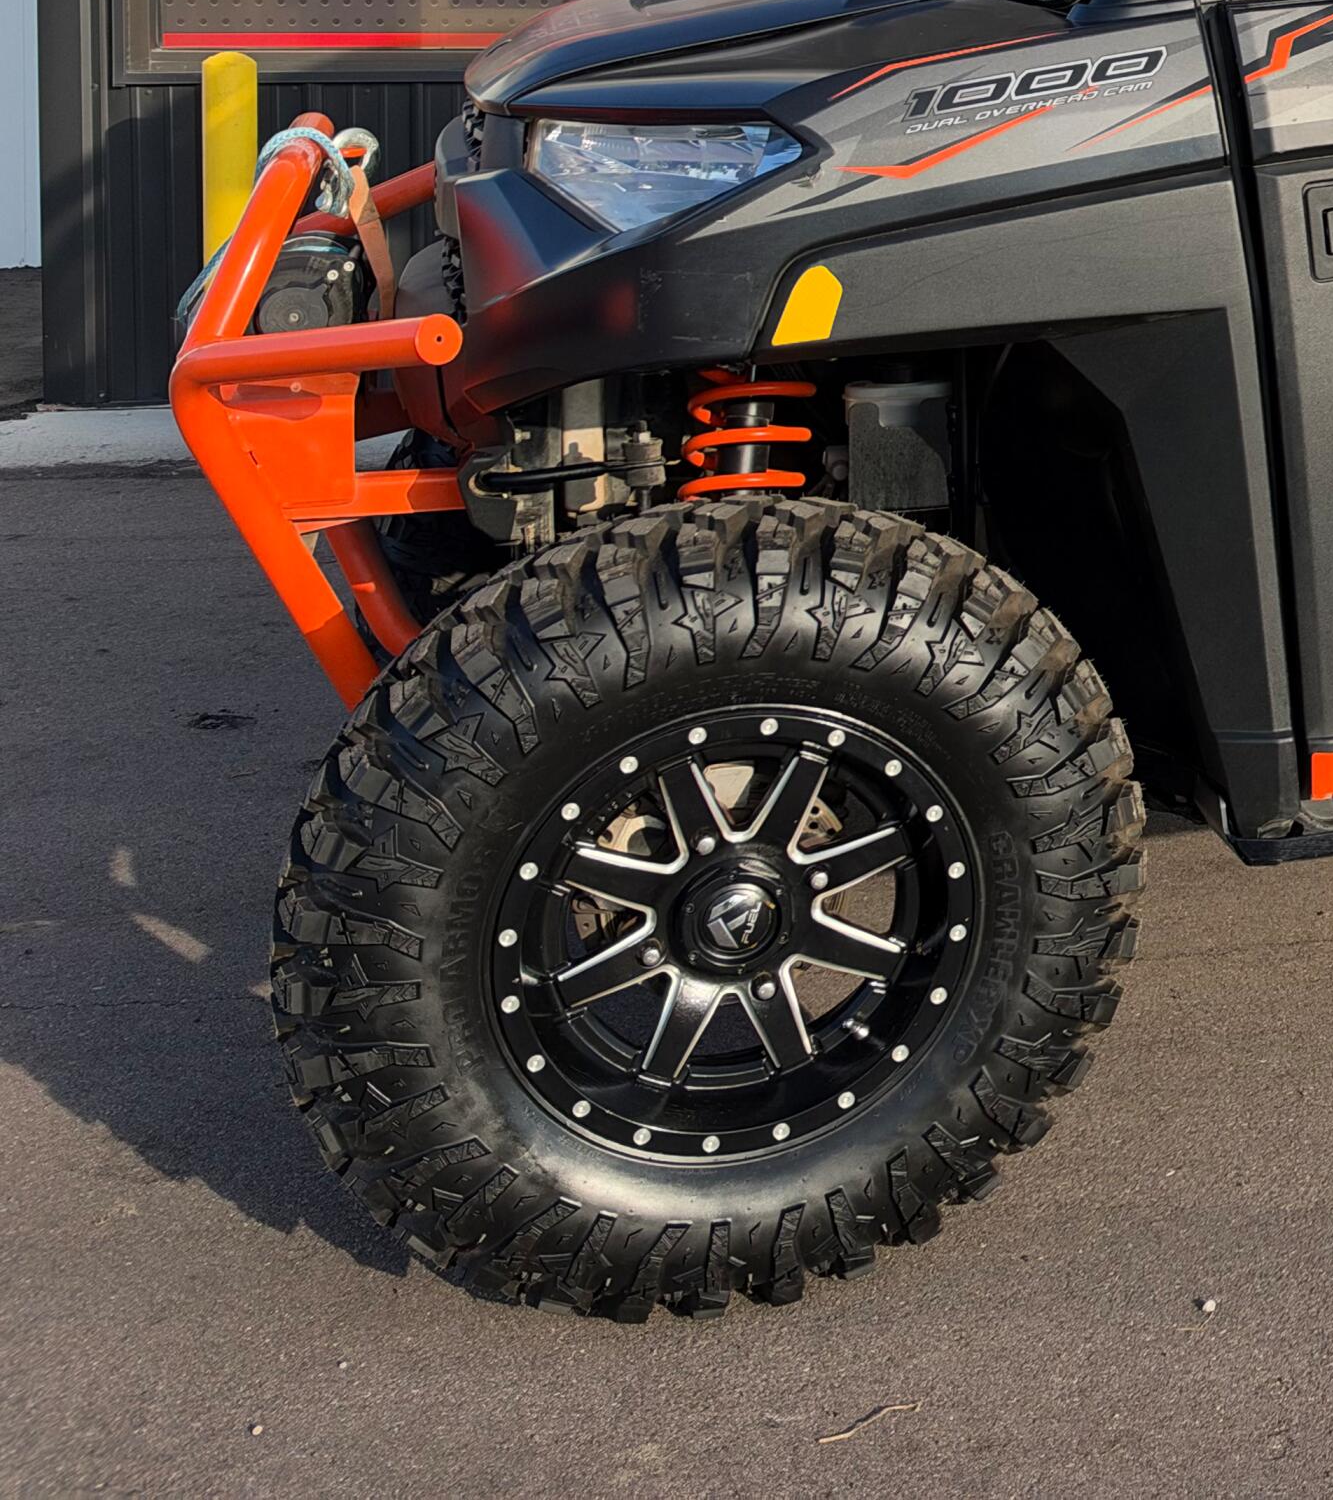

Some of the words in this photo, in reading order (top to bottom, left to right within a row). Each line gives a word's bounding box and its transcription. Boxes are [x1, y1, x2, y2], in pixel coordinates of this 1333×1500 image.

[902, 45, 1168, 122] 1000
[905, 115, 969, 135] DUAL
[974, 90, 1099, 121] OVERHEAD
[1102, 81, 1153, 97] CAM
[740, 899, 765, 945] FUEL
[972, 830, 1022, 1009] CRAWLER
